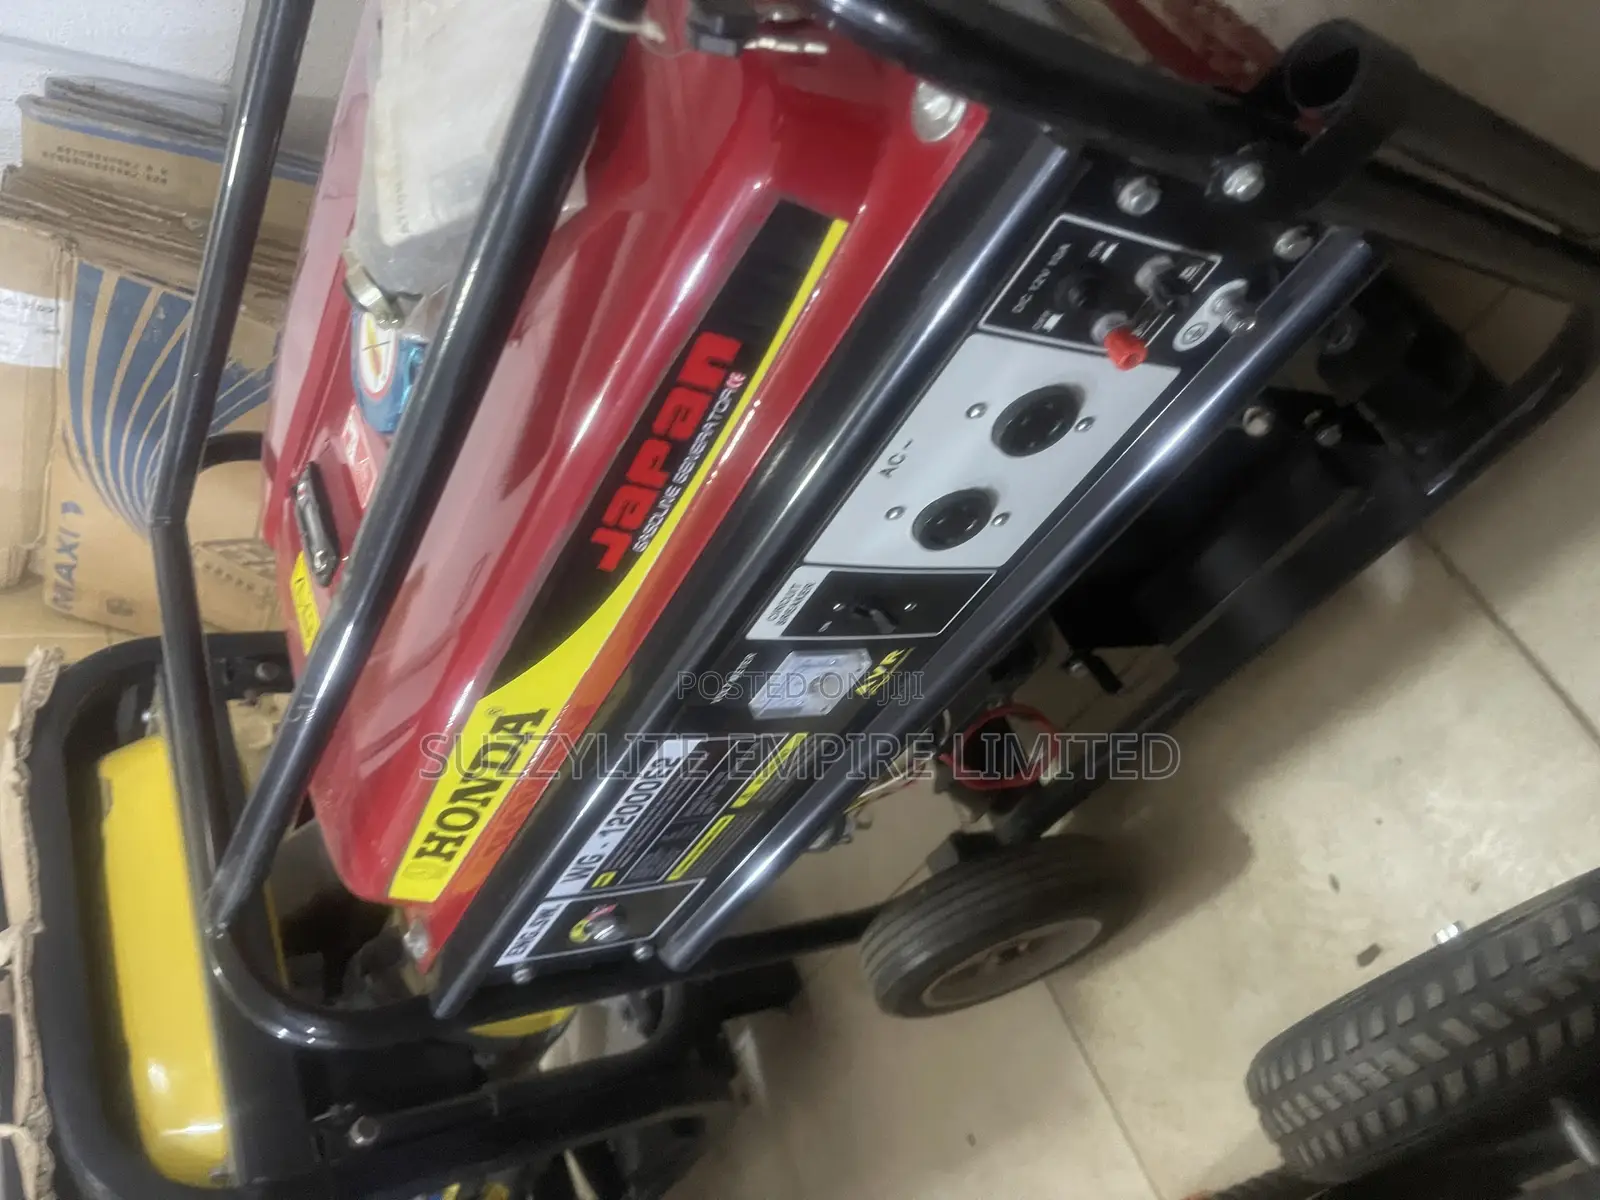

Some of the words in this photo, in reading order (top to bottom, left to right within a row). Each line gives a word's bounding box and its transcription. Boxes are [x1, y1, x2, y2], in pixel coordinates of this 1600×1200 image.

[632, 484, 682, 552] GASOLINE
[671, 388, 738, 484] GENERATOR
[53, 524, 81, 612] MAXI
[775, 580, 817, 627] BREAKER
[413, 707, 551, 863] HONDA
[560, 854, 604, 885] WG
